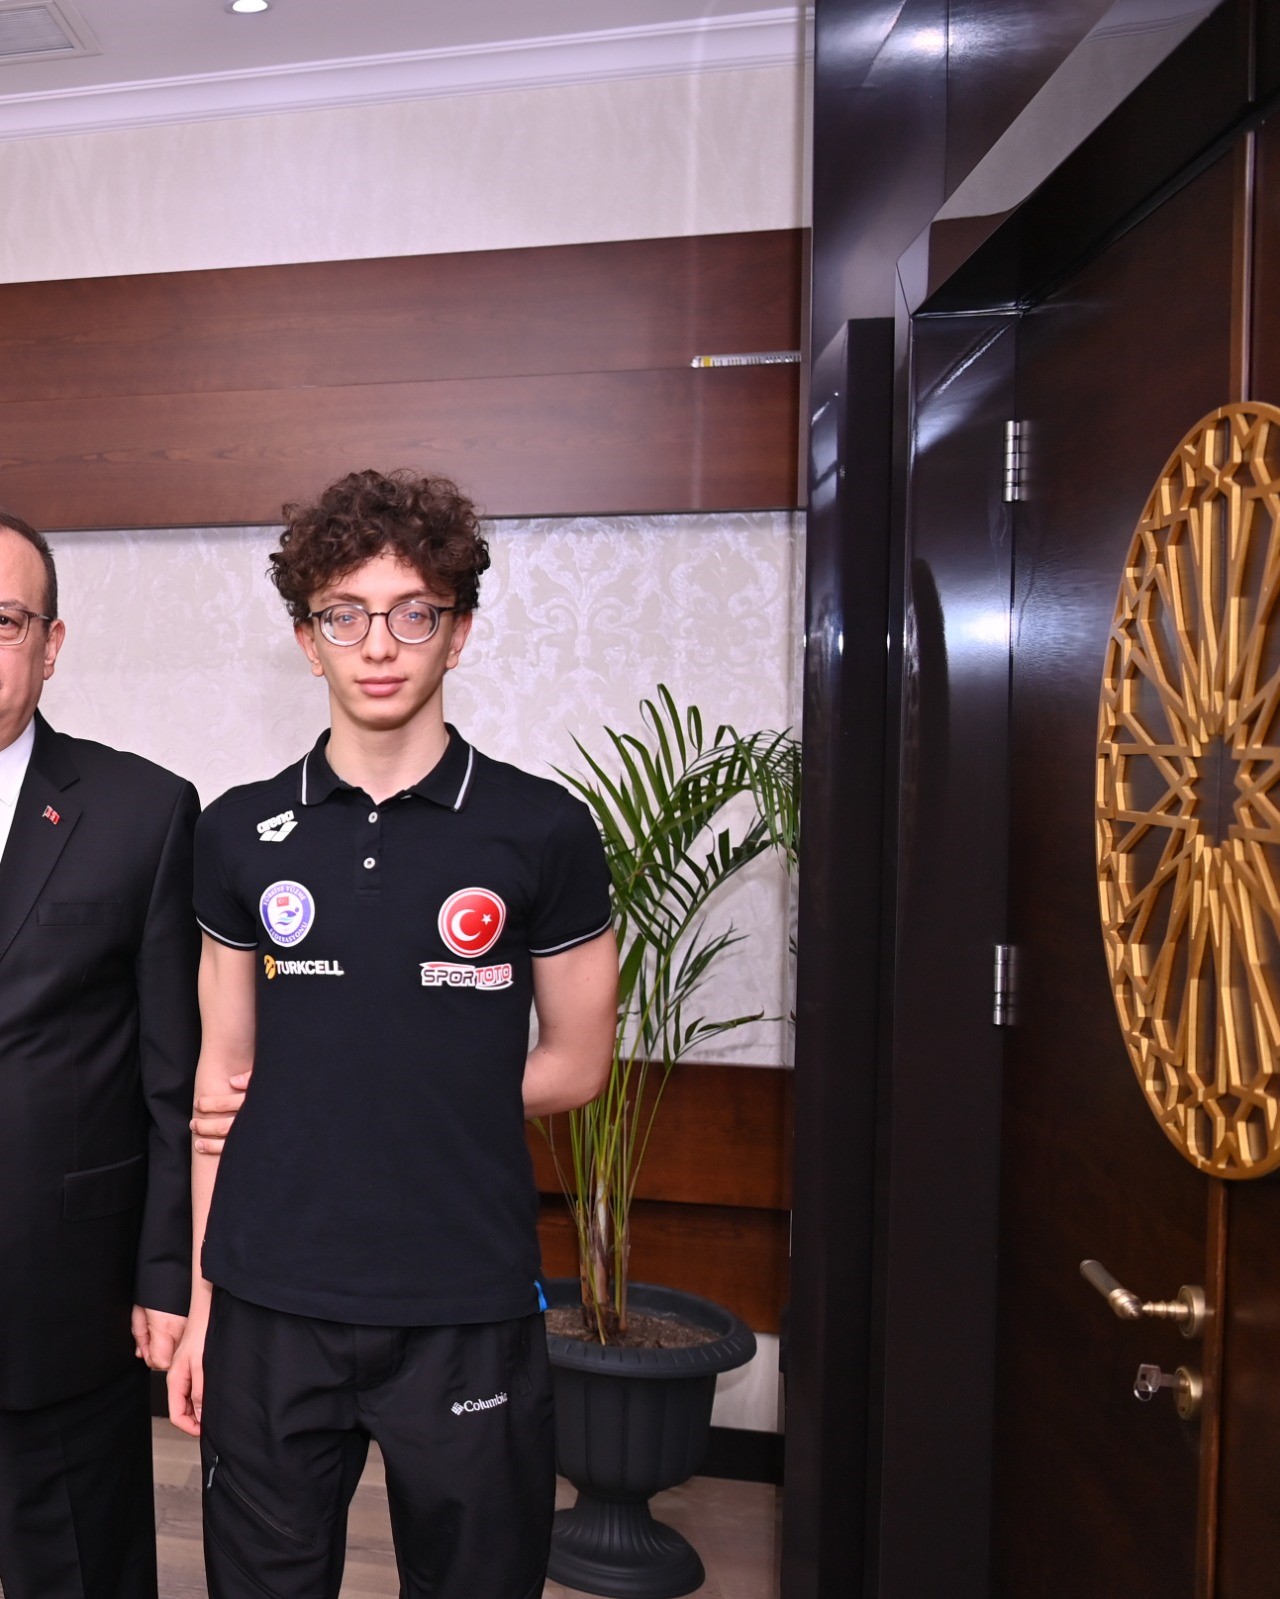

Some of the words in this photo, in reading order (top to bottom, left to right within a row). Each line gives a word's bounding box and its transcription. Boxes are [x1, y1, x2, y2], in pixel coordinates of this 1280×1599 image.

[256, 809, 295, 834] arena
[275, 960, 345, 976] TURKCELL
[463, 1391, 508, 1412] Columbia
